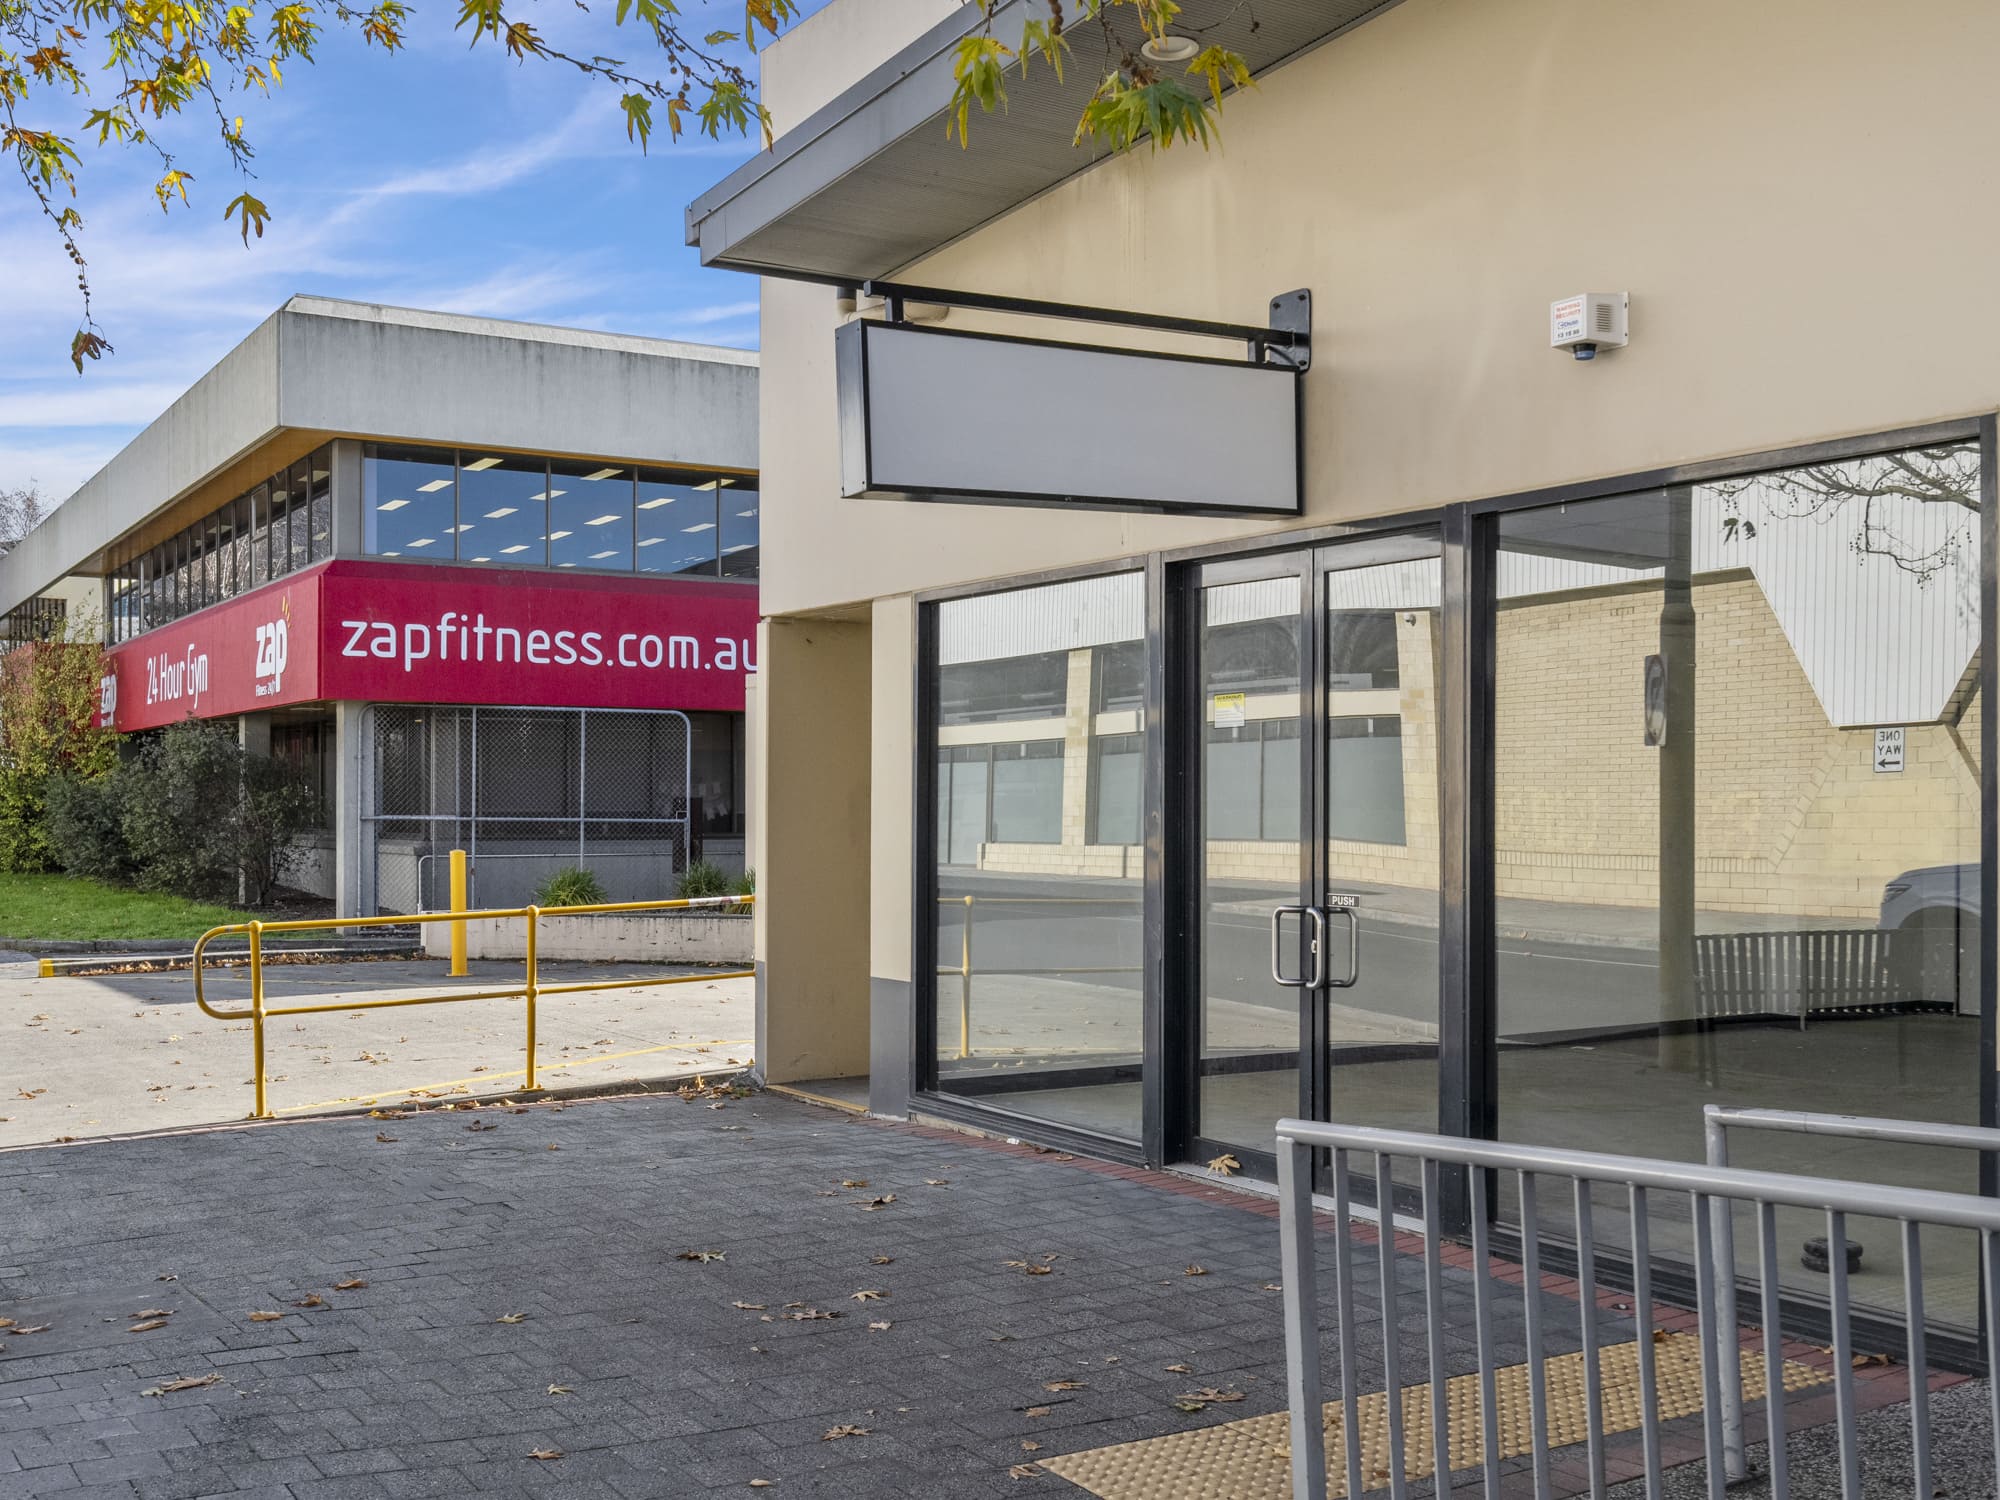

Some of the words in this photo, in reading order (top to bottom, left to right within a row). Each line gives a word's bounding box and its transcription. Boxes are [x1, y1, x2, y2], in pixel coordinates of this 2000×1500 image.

[147, 656, 158, 705] 24
[160, 652, 185, 702] Hour
[187, 643, 208, 710] Gym
[256, 619, 287, 692] zap
[1331, 895, 1355, 906] PUSH
